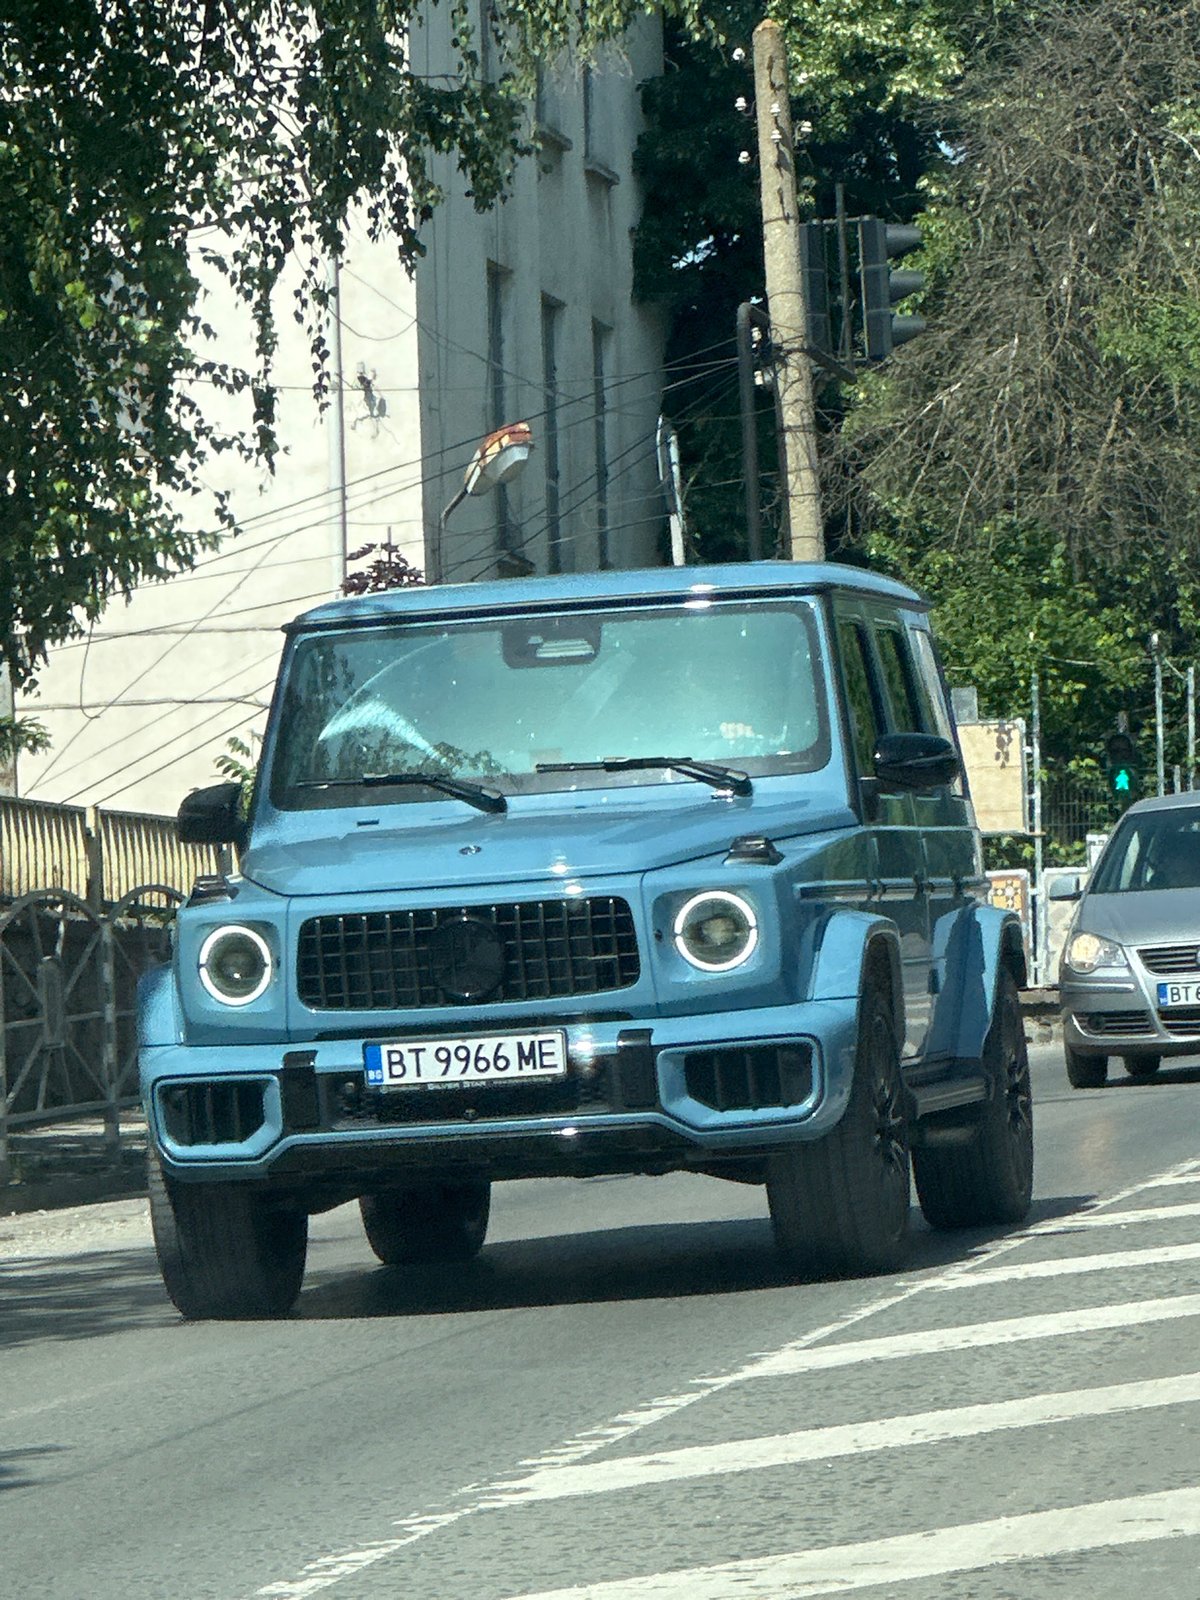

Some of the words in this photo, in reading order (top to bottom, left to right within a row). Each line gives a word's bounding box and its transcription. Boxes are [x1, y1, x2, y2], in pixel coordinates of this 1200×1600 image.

[1170, 986, 1192, 1003] BT
[387, 1048, 426, 1079] BT
[434, 1043, 511, 1077] 9966
[518, 1040, 559, 1072] ME
[368, 1070, 383, 1080] BG
